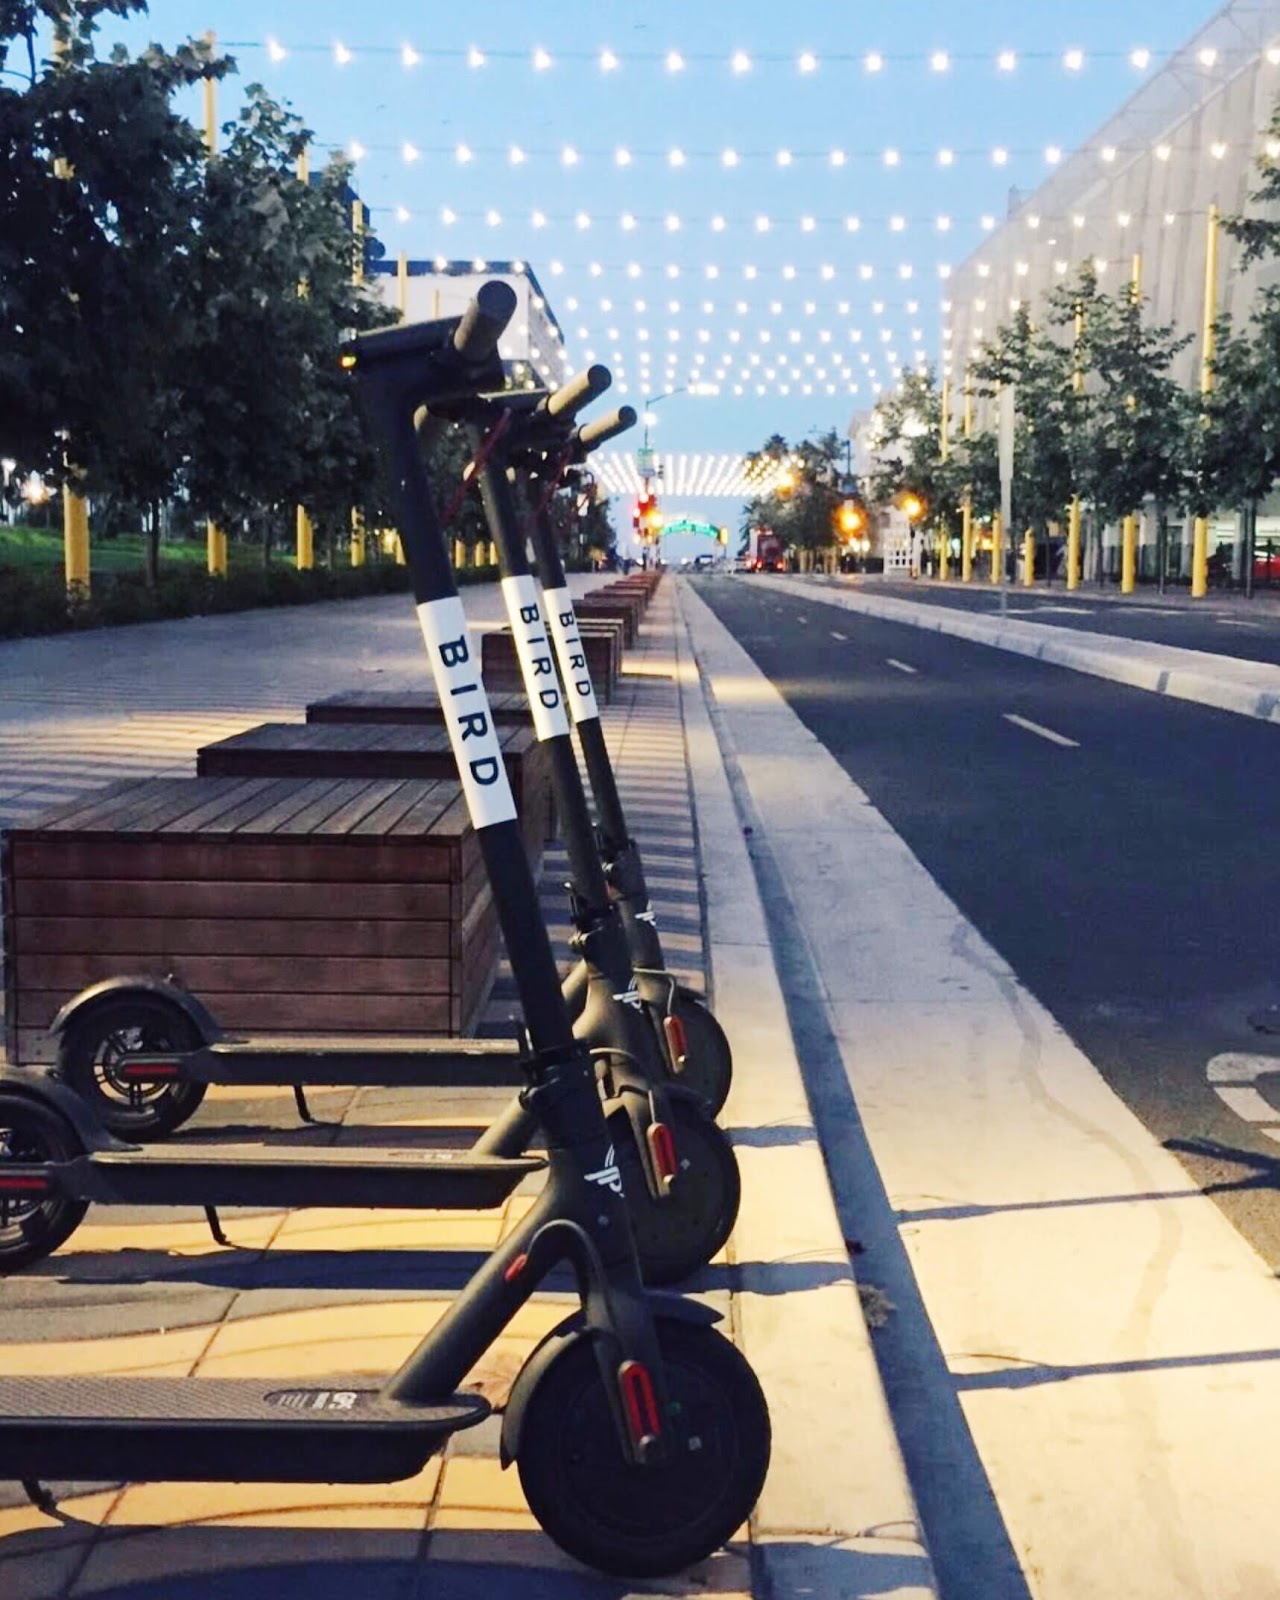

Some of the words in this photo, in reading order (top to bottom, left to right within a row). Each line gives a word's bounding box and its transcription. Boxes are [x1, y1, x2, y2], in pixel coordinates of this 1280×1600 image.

[520, 602, 559, 709] BIRD
[559, 610, 592, 698] BIRD
[438, 634, 500, 787] BIRD
